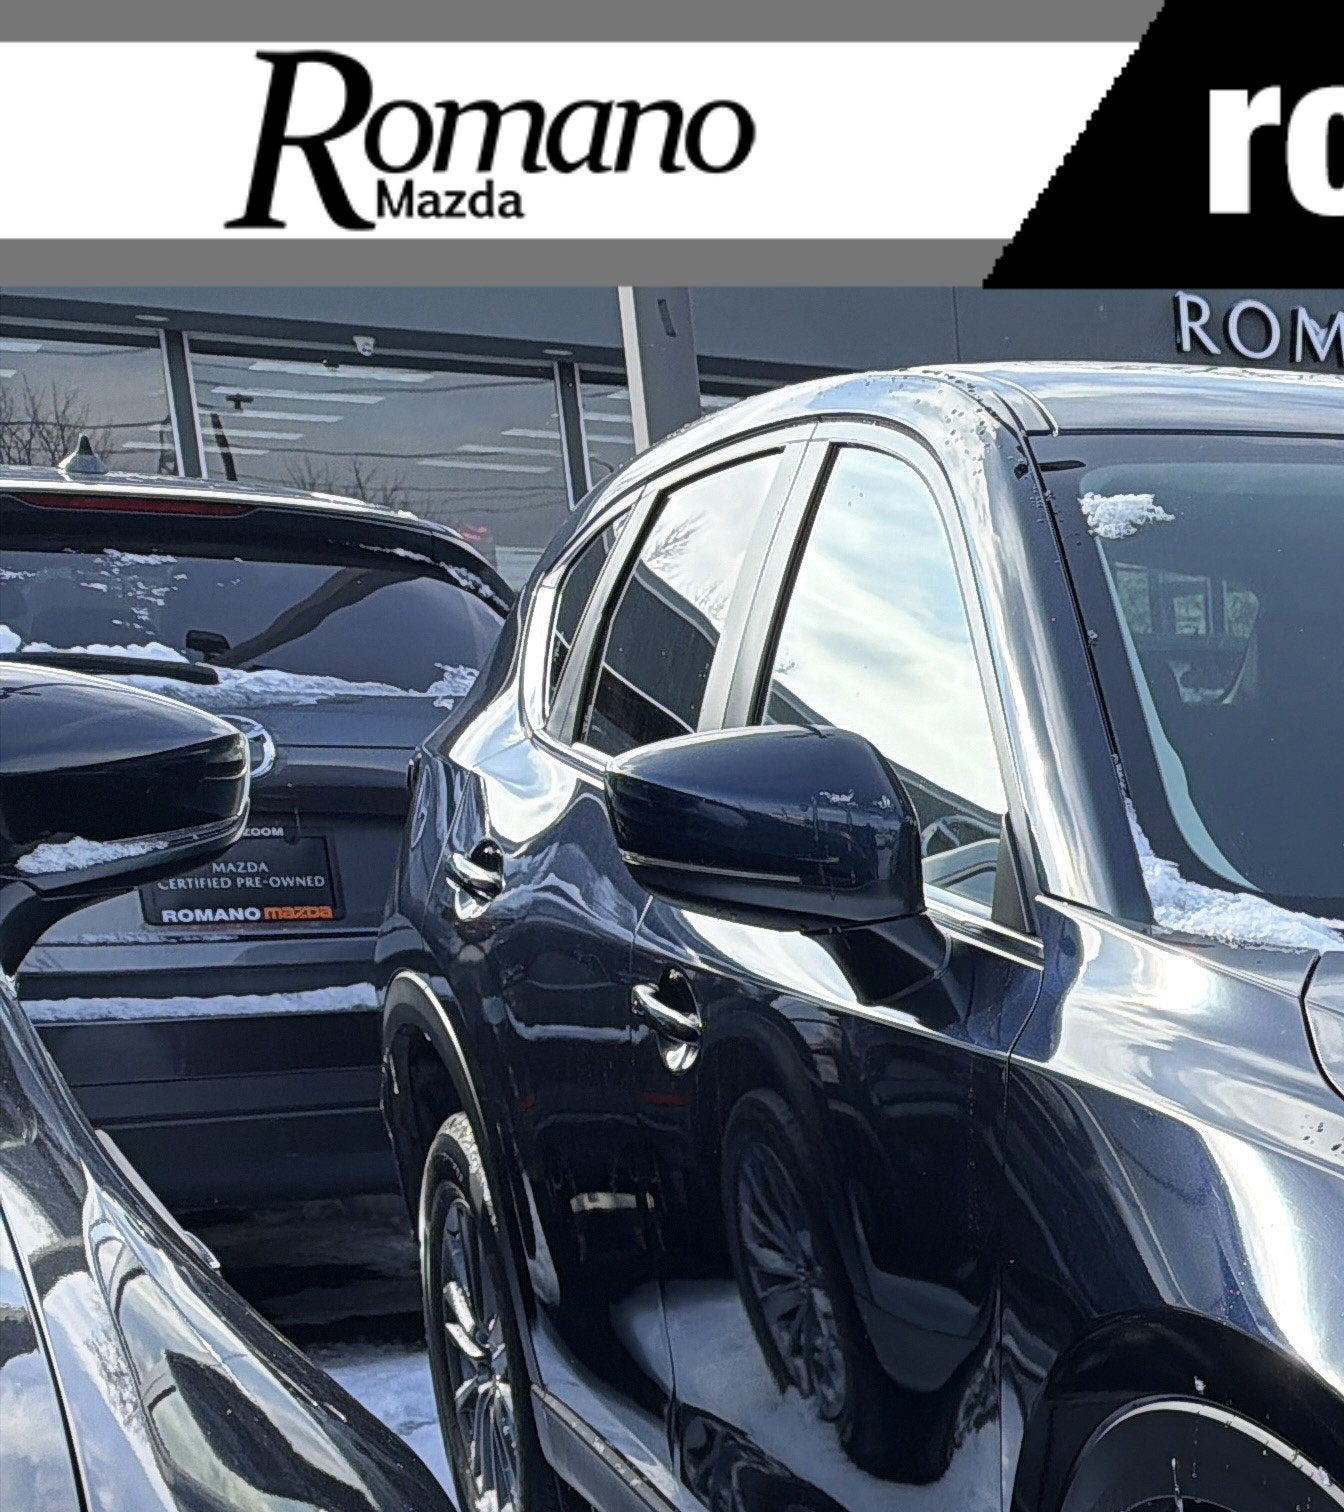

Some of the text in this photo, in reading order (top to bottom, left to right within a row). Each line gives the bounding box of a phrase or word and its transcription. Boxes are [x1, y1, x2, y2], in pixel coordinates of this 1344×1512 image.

[212, 861, 269, 874] MAZDA
[158, 875, 326, 890] CERTIFIED PRE-OWNED
[162, 905, 333, 922] ROMANO mazda
